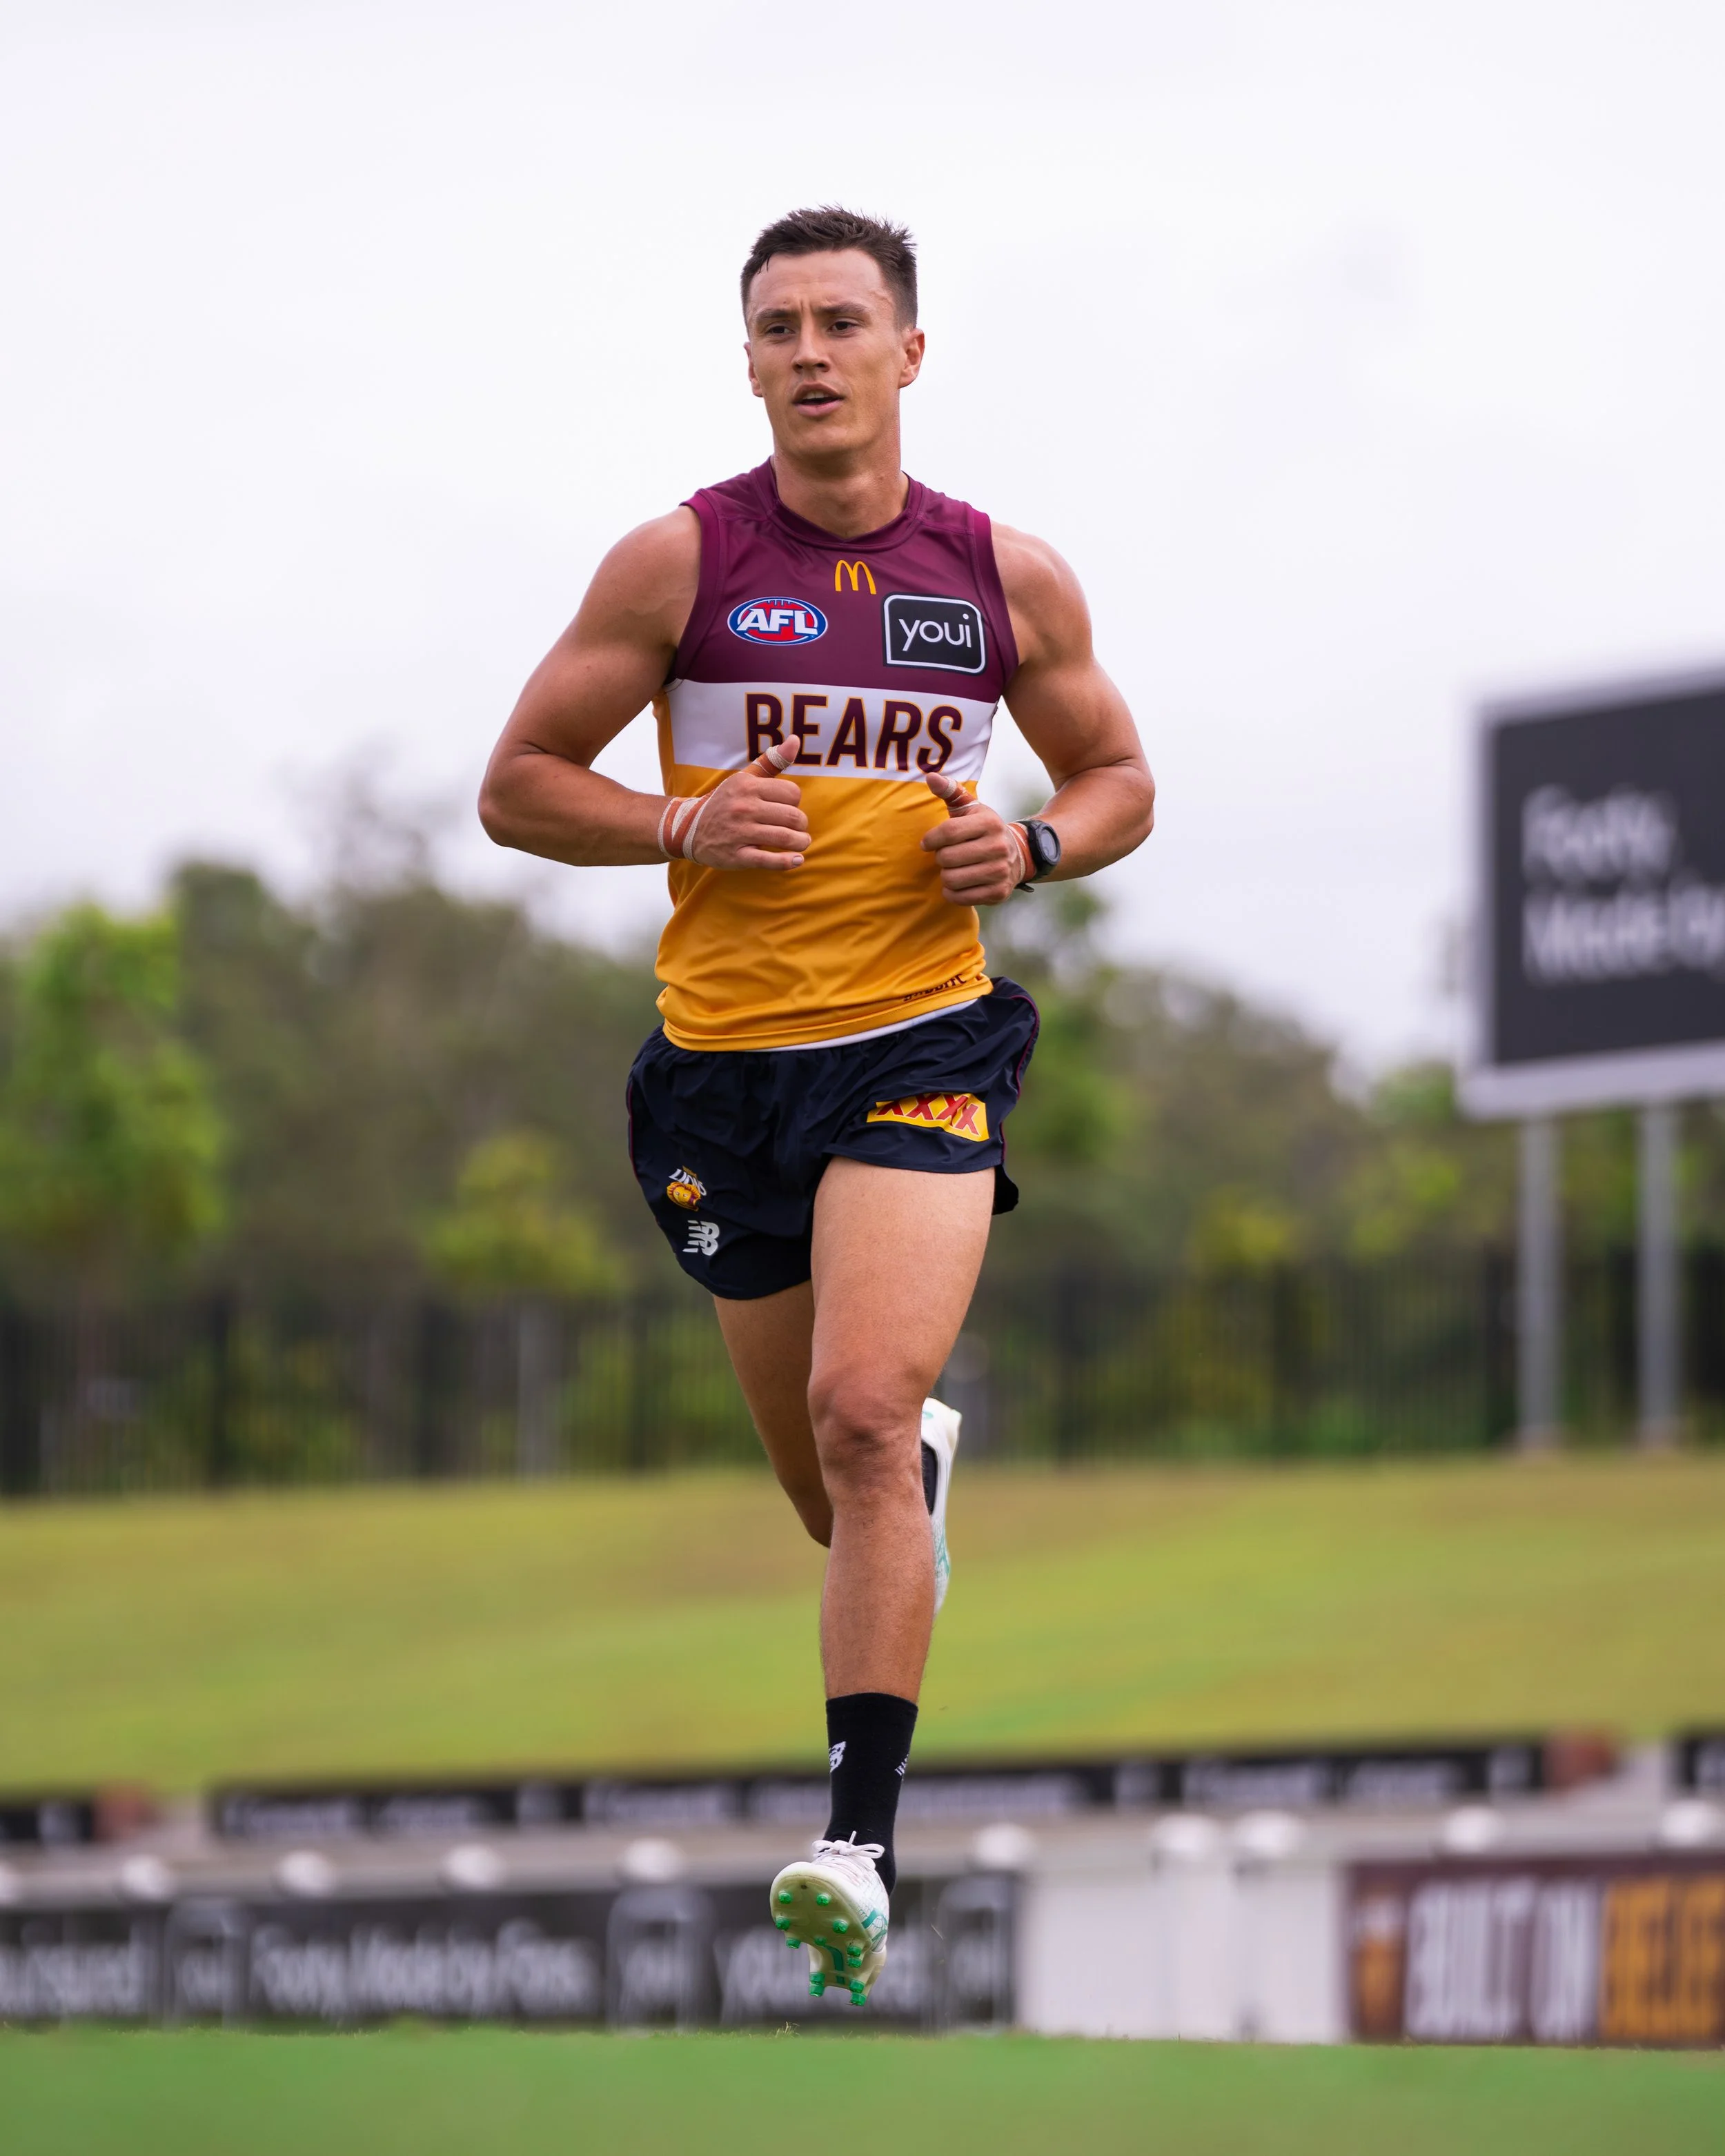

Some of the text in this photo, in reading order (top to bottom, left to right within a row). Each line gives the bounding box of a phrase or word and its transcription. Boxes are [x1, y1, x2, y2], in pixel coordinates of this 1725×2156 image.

[736, 608, 818, 635] AFL
[898, 613, 972, 652] youi
[745, 692, 963, 774] BEARS
